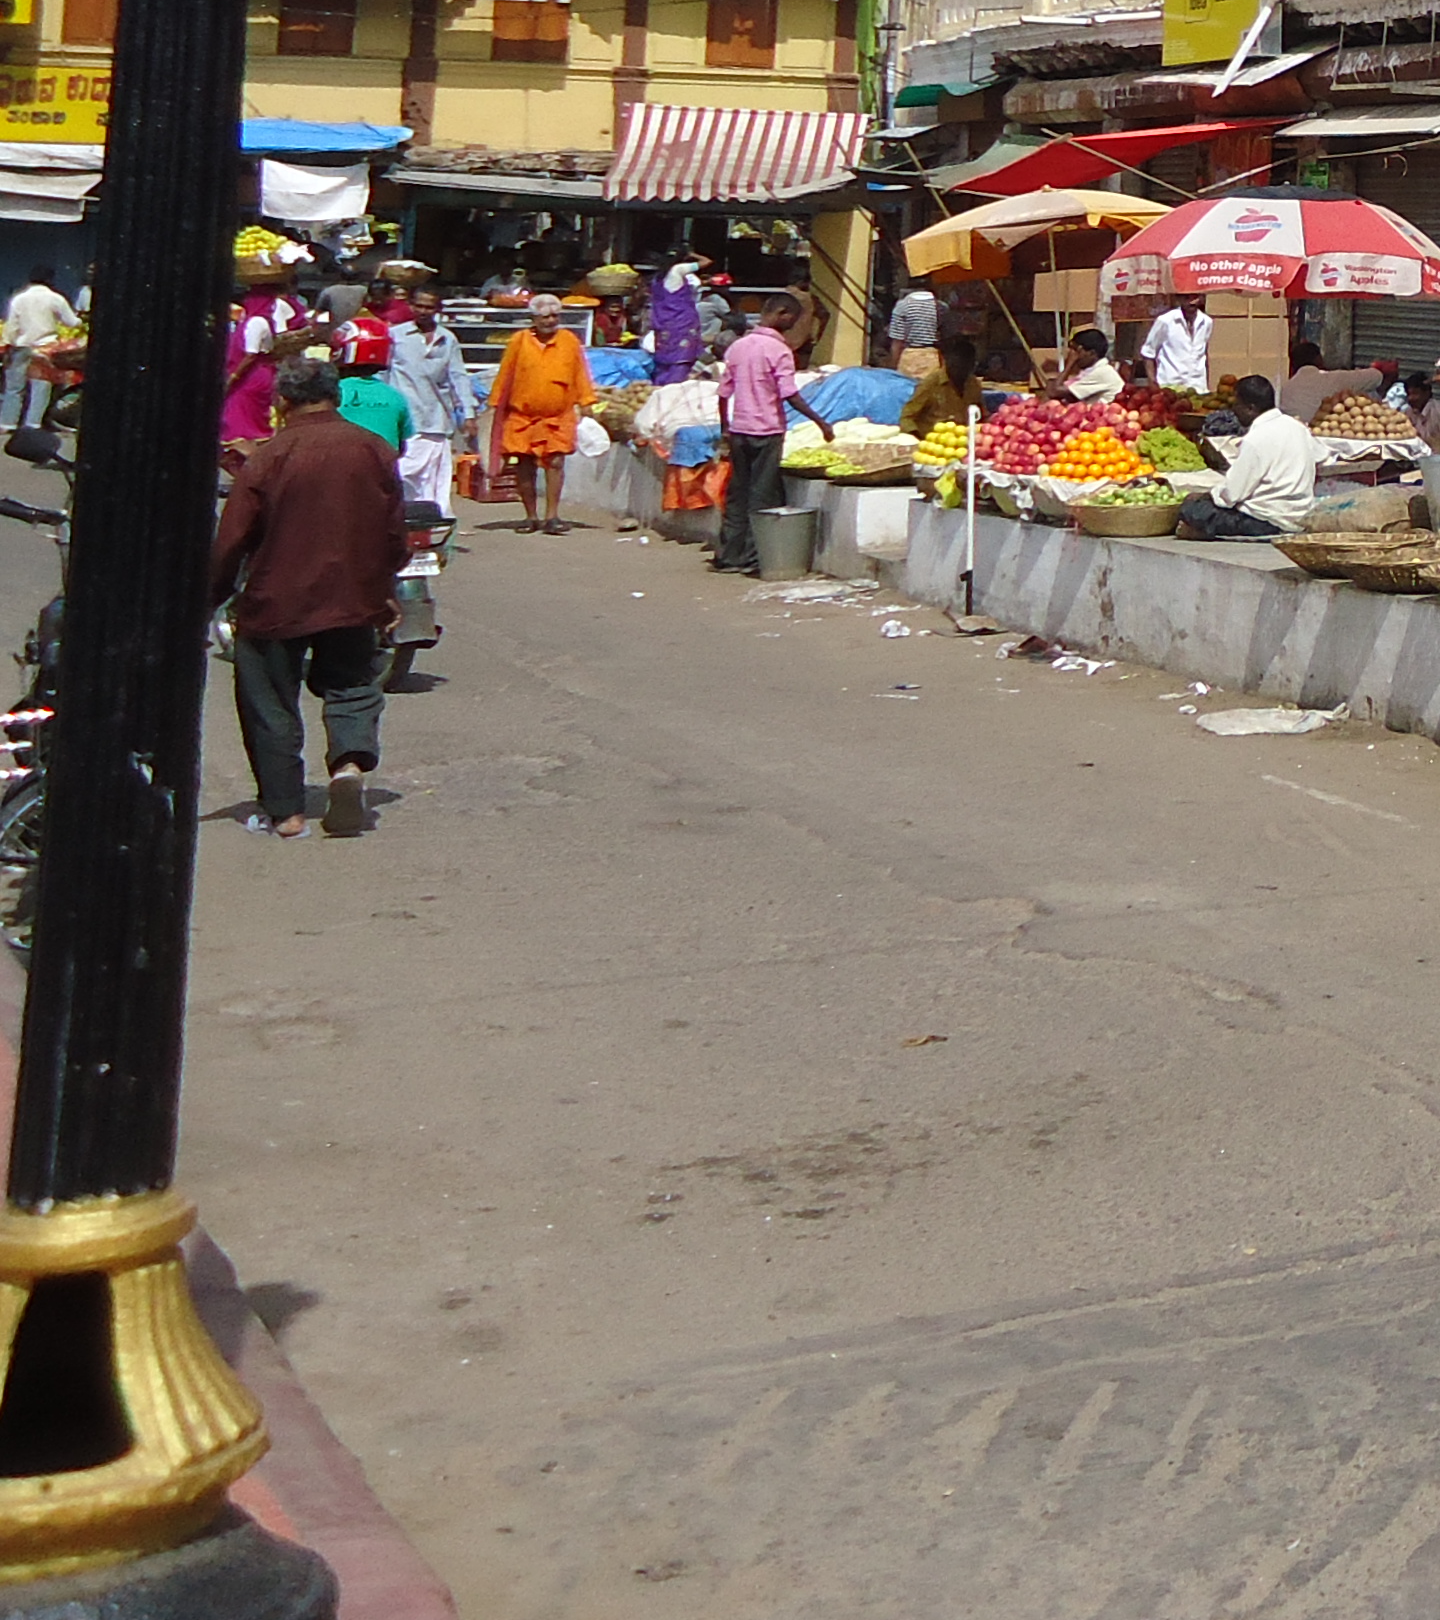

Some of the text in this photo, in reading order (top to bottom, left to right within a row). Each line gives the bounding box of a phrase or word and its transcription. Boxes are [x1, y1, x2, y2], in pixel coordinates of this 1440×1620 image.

[1190, 260, 1282, 277] No other apple
[1197, 274, 1273, 289] comes close.
[1350, 275, 1389, 286] Apples
